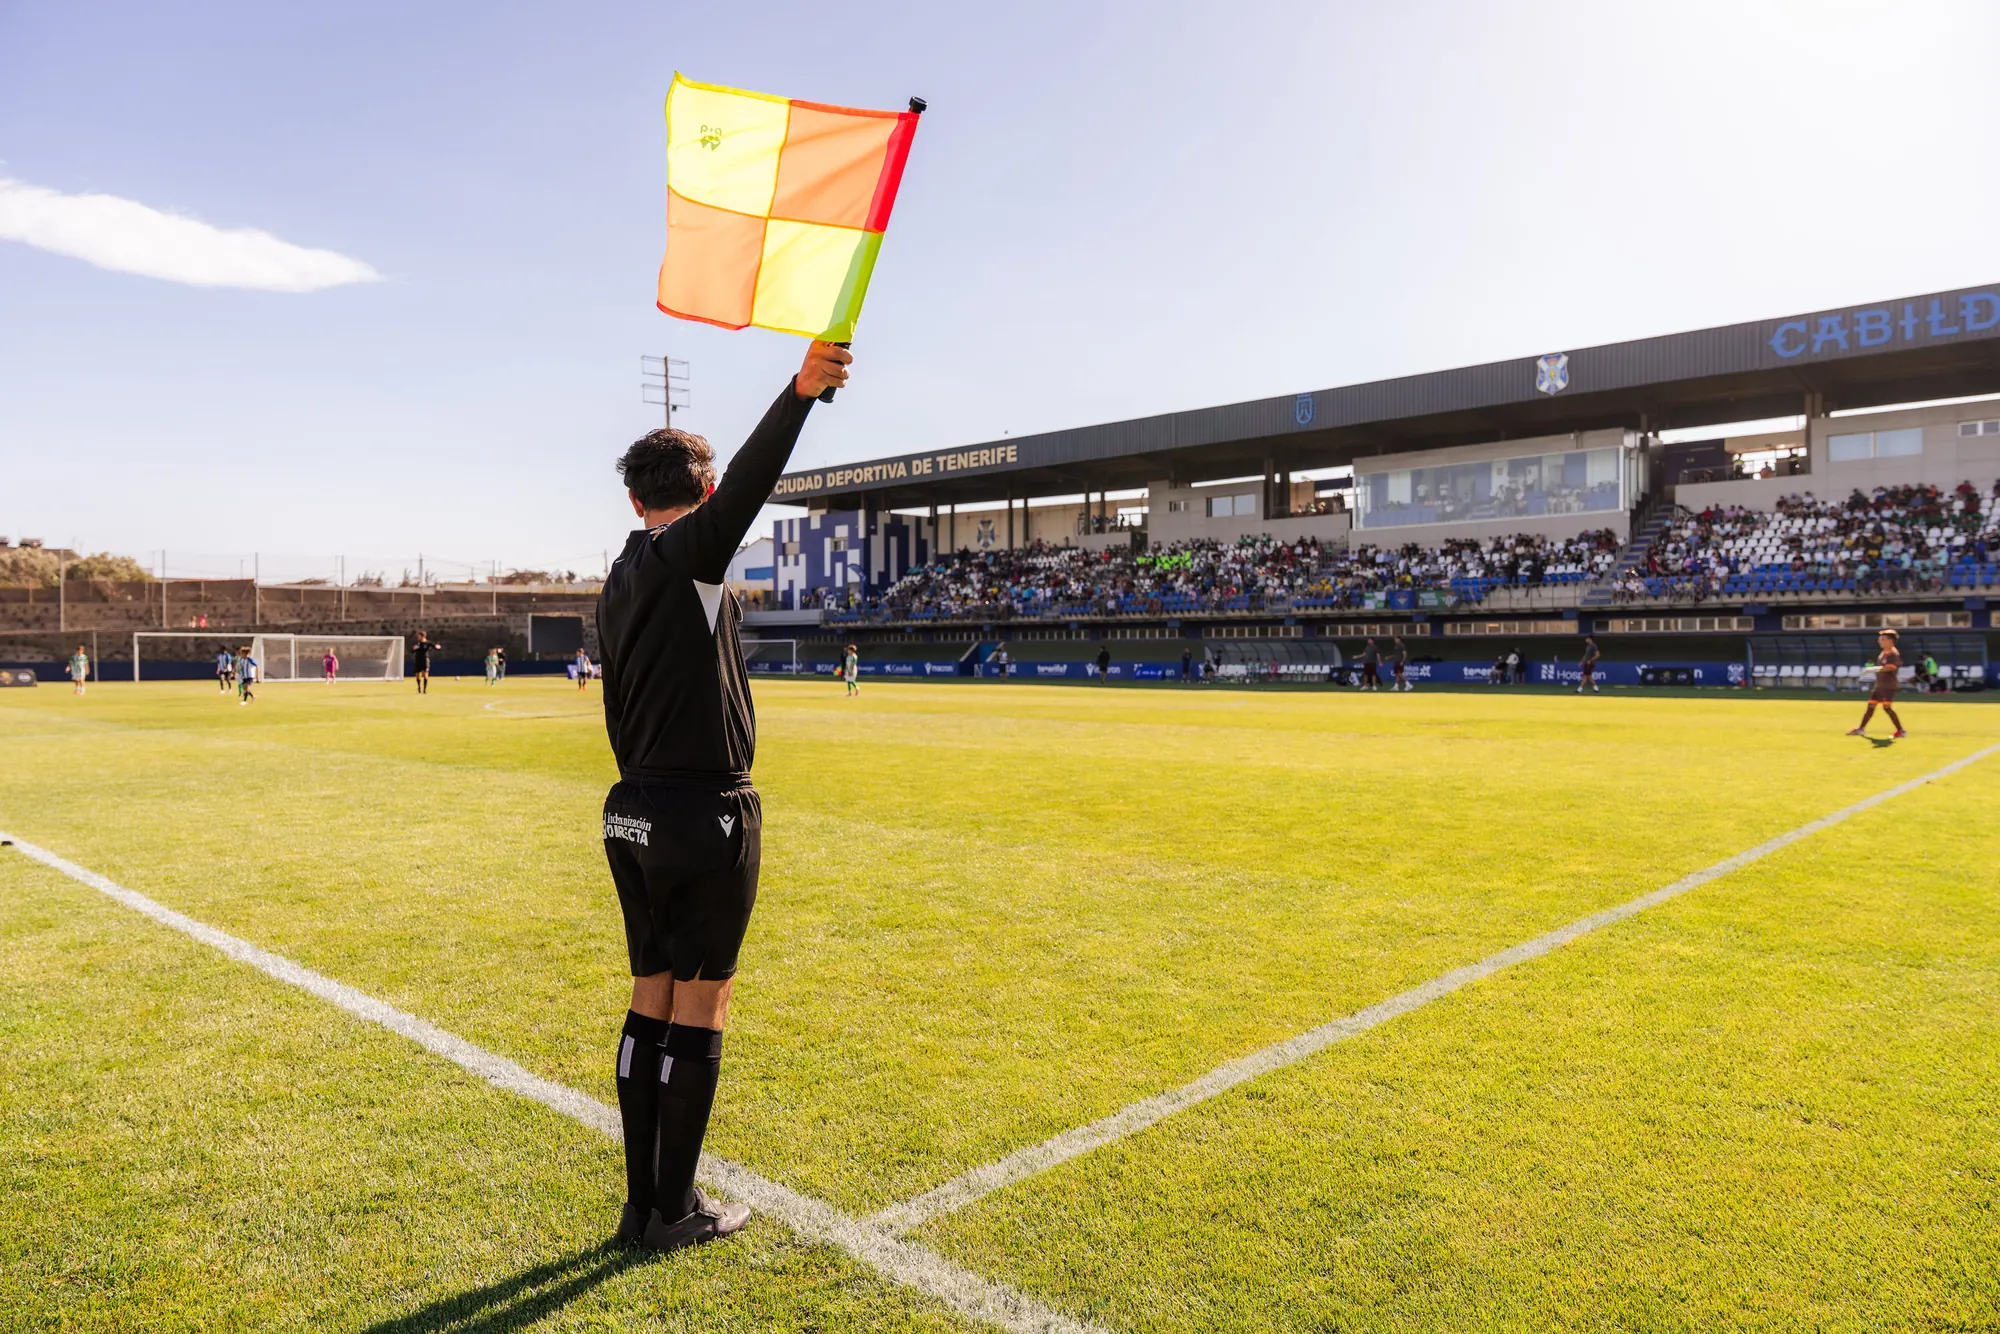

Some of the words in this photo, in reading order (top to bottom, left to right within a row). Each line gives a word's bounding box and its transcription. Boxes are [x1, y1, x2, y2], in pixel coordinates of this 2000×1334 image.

[774, 475, 823, 495] CIUDAD
[826, 462, 908, 488] DEPORTIVA
[911, 458, 933, 476] DE
[936, 445, 1018, 473] TENERIFE
[1556, 671, 1606, 681] Hospen
